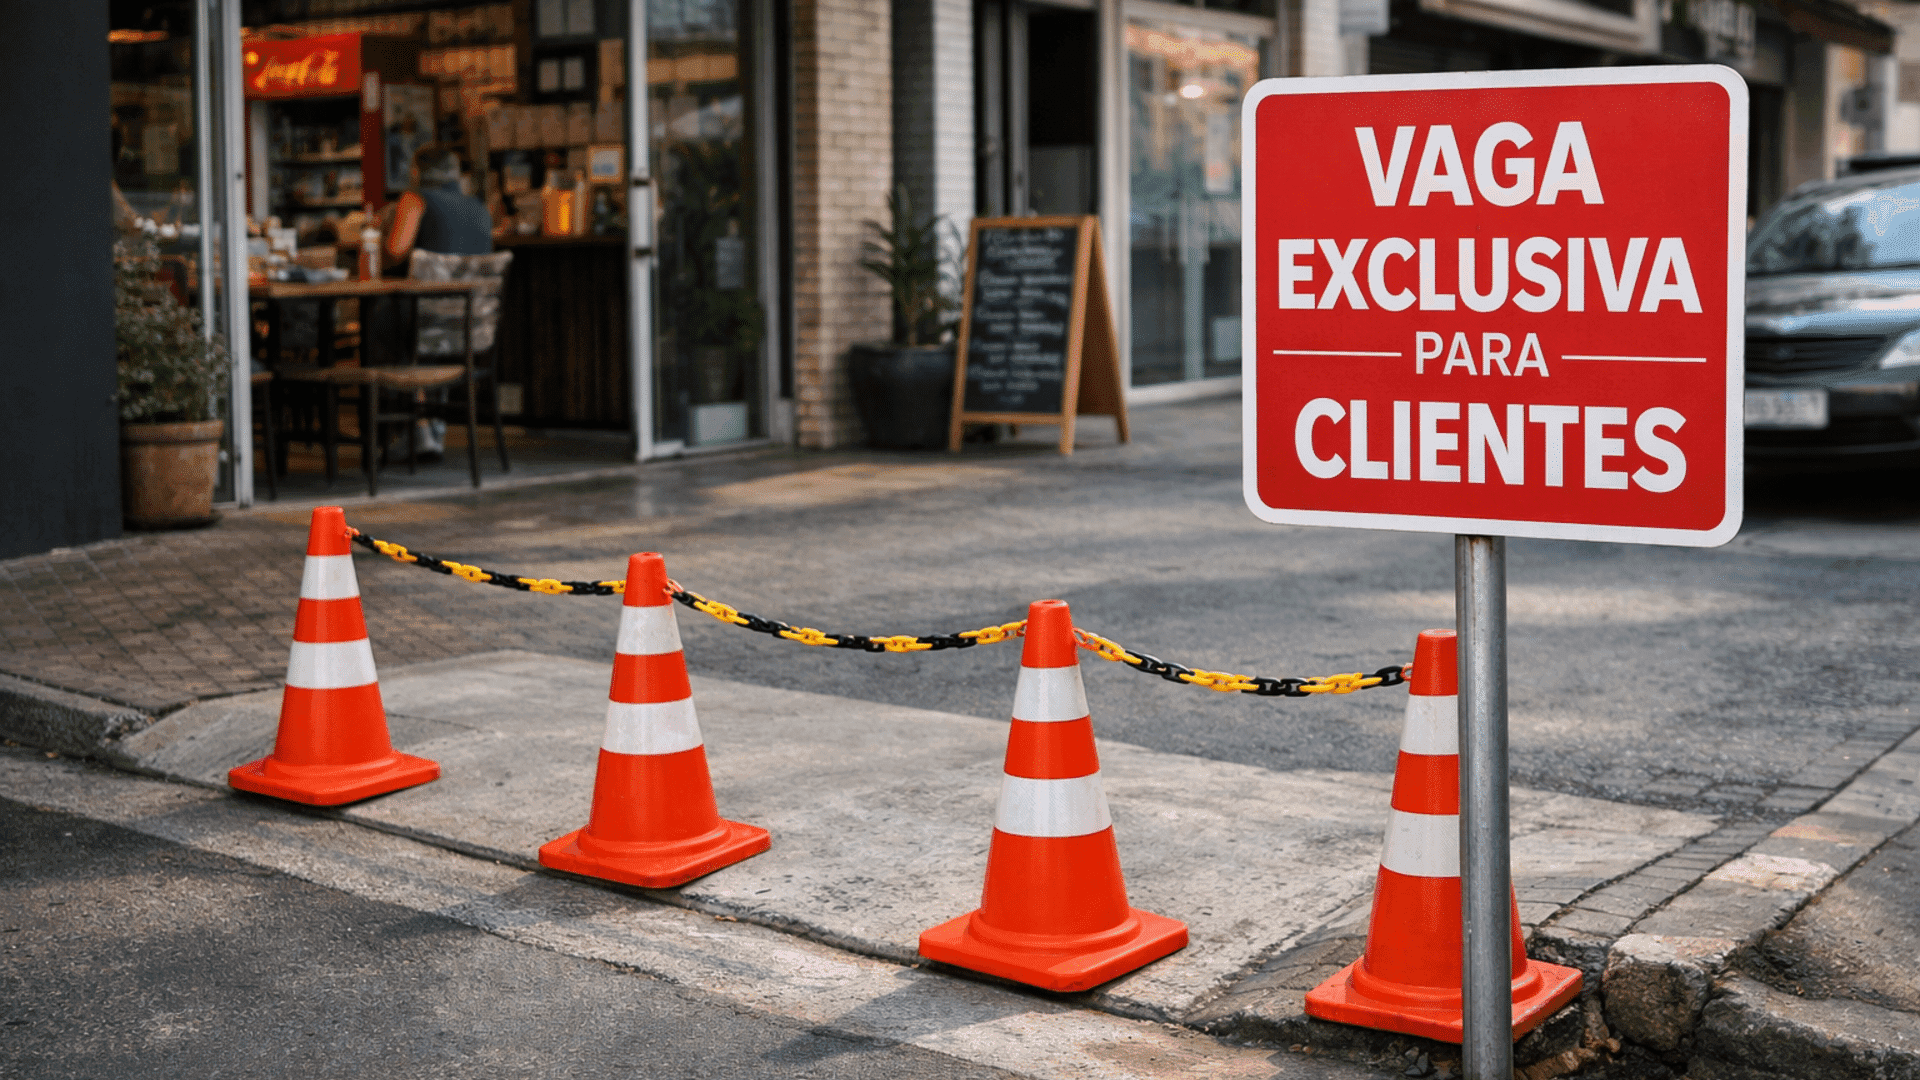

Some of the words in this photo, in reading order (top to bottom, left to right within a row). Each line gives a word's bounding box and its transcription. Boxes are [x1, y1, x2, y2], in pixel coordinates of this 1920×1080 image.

[1355, 121, 1604, 207] VAGA
[1277, 236, 1703, 314] EXCLUSIVA
[1415, 331, 1550, 377] PARA
[1294, 398, 1687, 494] CLIENTES
